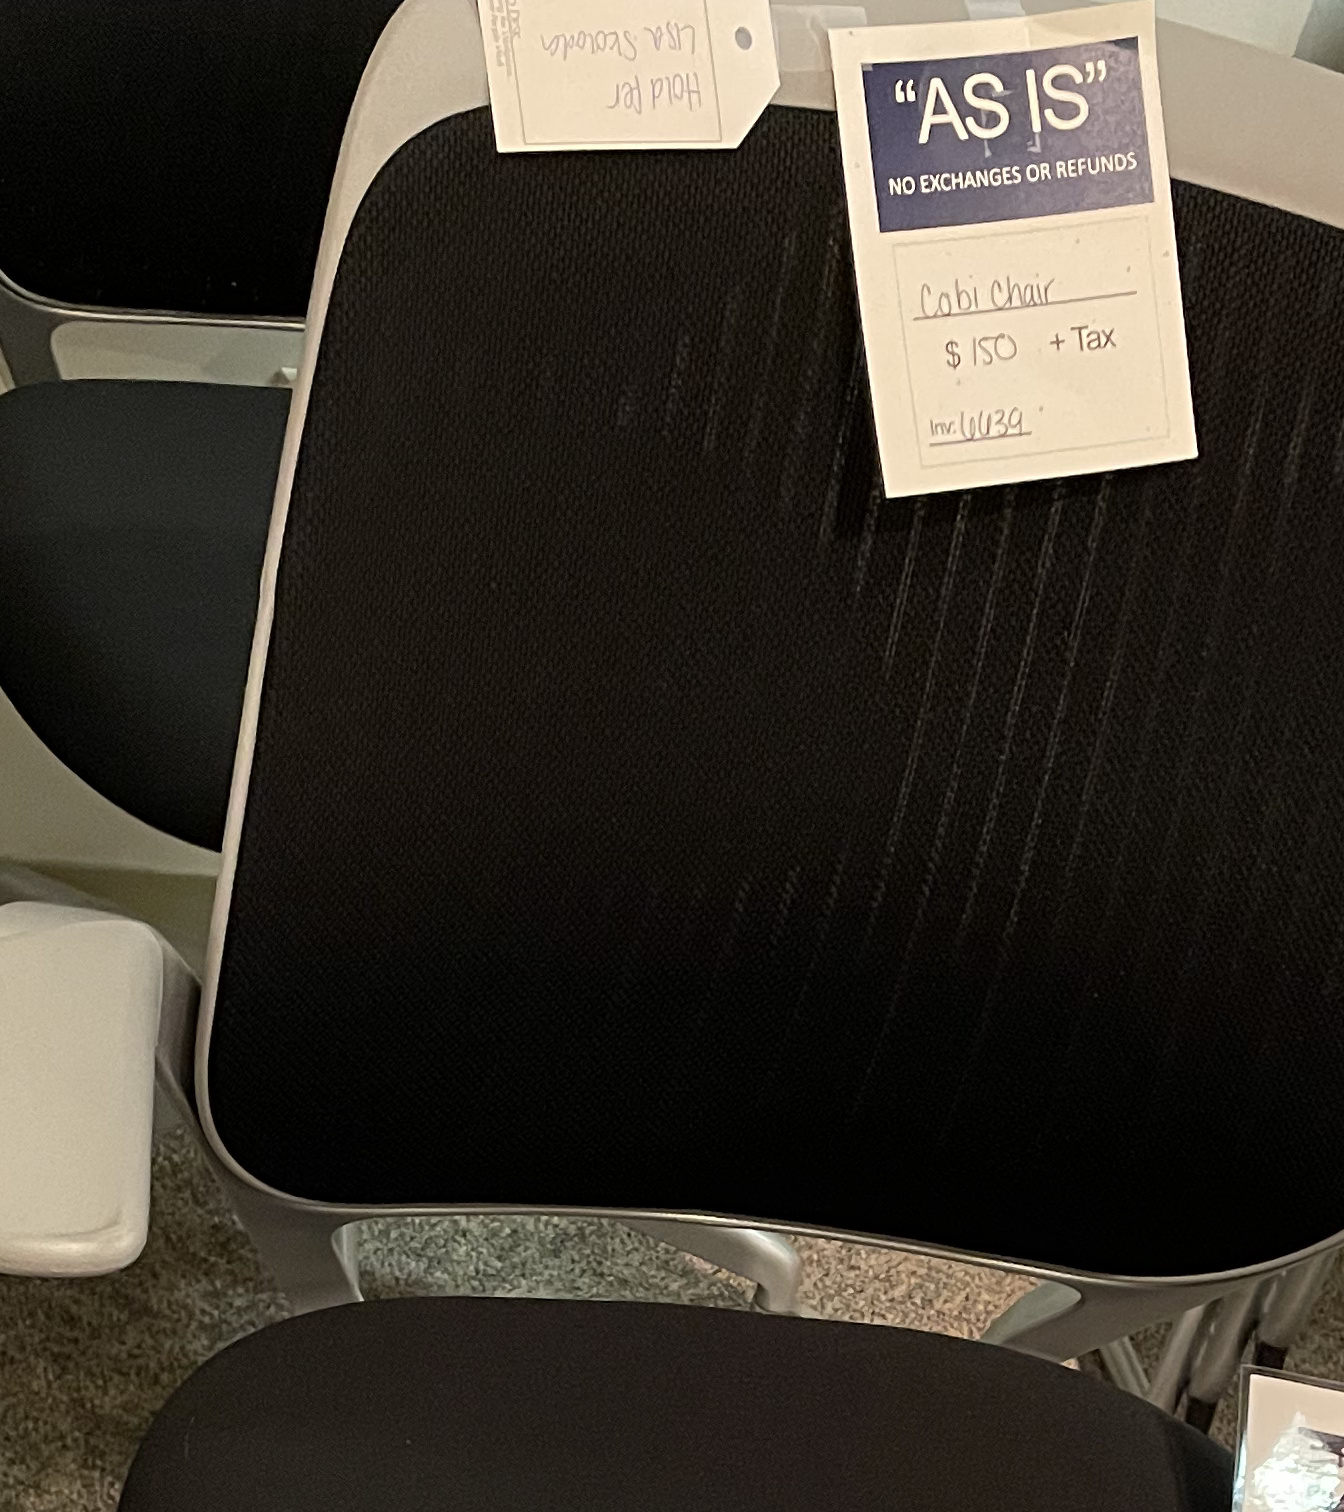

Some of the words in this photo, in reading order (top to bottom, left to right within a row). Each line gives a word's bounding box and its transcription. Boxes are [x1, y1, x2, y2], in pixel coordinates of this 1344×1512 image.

[651, 71, 702, 112] Hold
[888, 176, 916, 197] NO
[920, 166, 1022, 194] EXCHANGES
[1025, 162, 1053, 183] OR
[1055, 151, 1138, 180] REFUNDS
[920, 274, 979, 318] Cobi
[990, 272, 1056, 309] Chair
[1071, 324, 1117, 352] Tax
